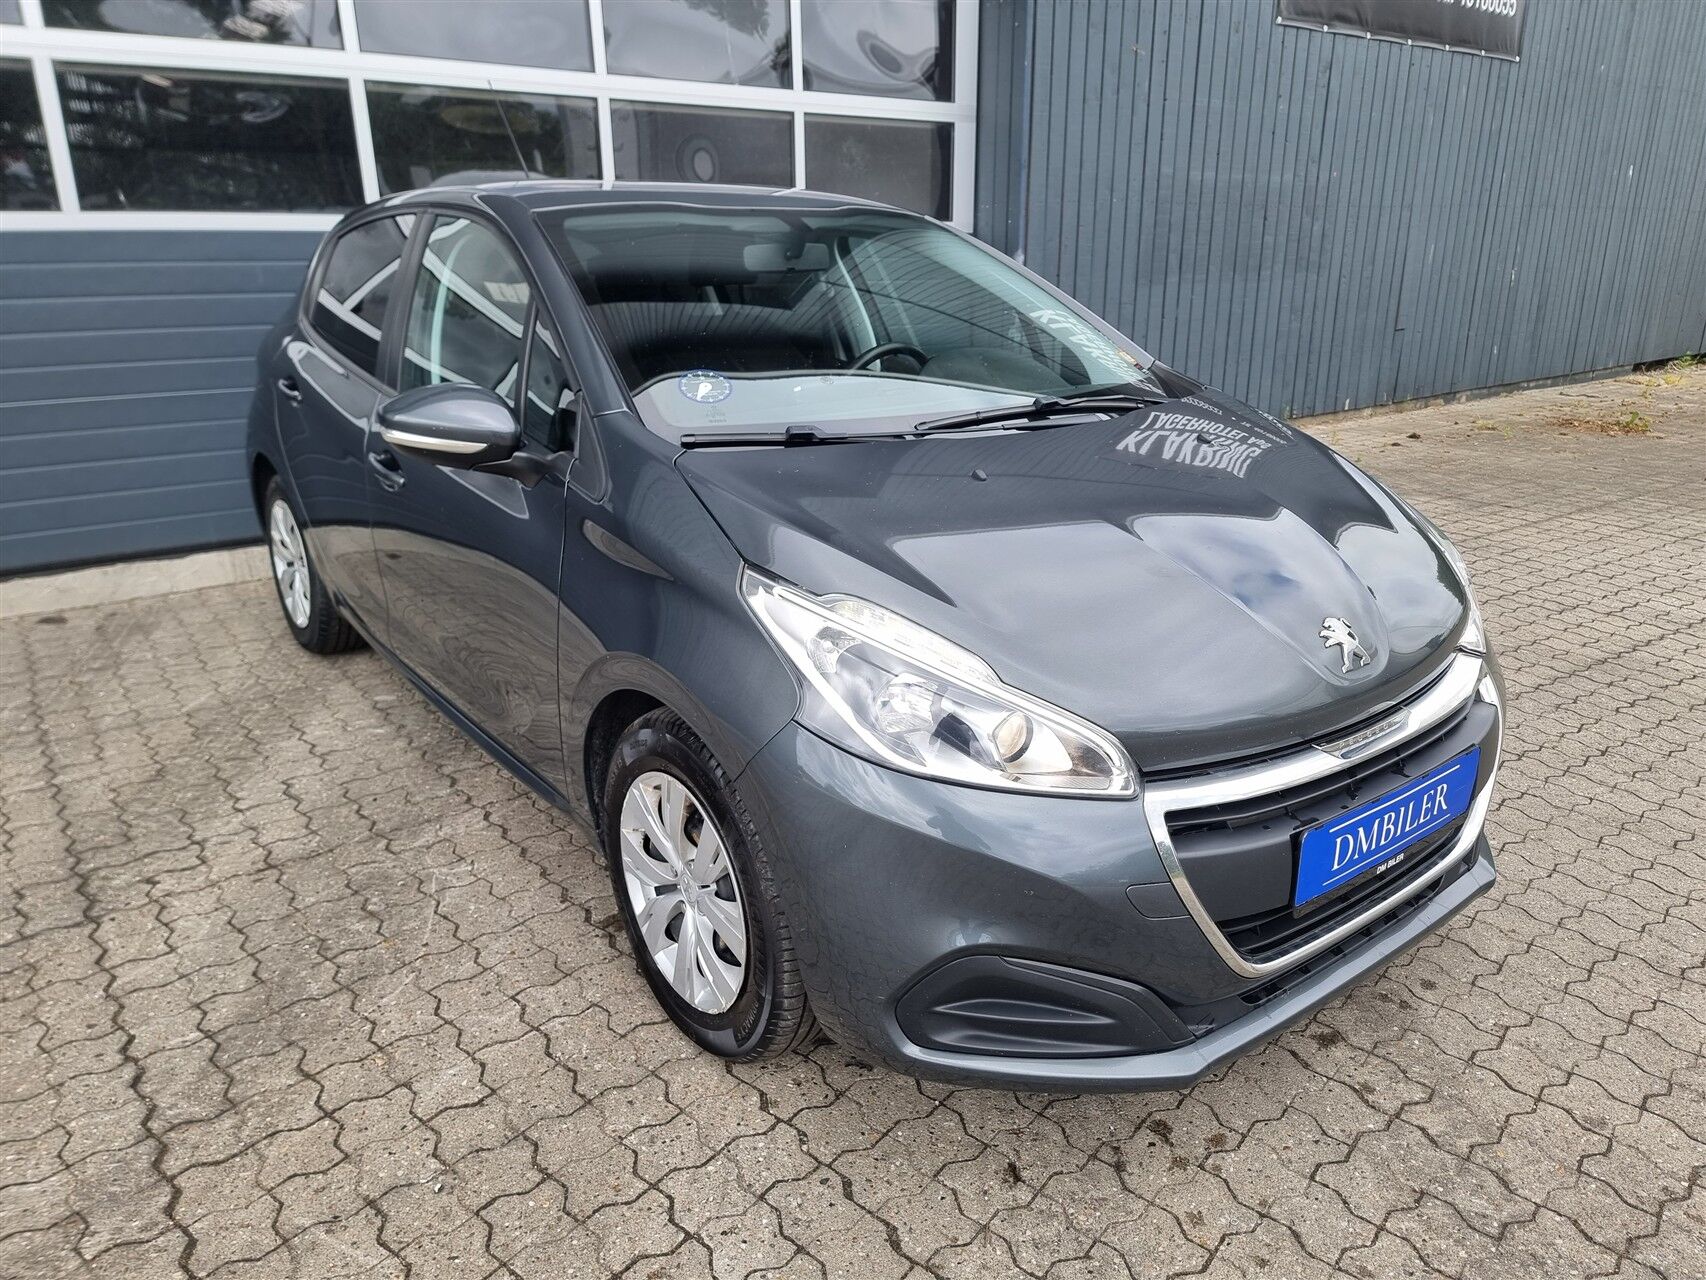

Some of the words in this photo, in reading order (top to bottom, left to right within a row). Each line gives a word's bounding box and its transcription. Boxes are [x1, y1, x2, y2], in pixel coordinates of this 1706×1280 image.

[1332, 783, 1448, 871] DMBILER
[1376, 864, 1387, 874] DM
[1388, 853, 1404, 868] BILER
